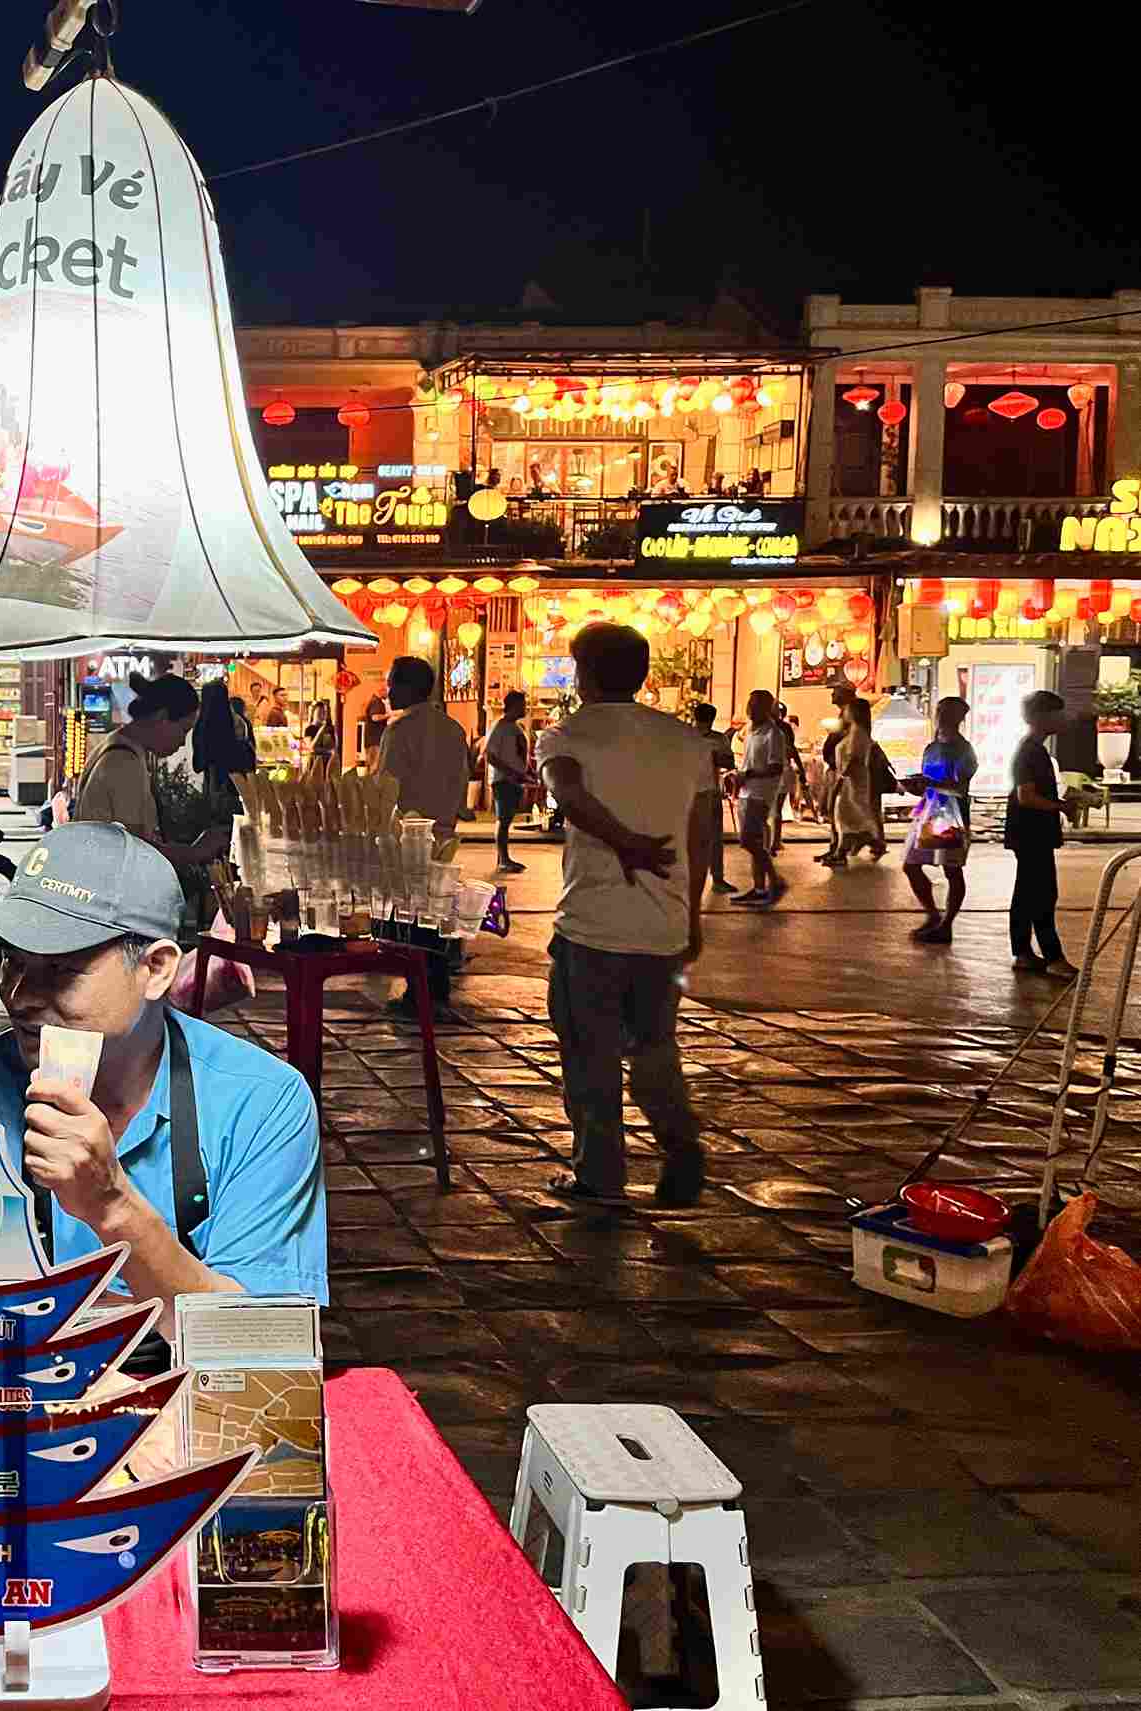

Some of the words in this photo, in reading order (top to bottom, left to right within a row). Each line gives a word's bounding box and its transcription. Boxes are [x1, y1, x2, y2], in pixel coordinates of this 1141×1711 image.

[80, 155, 145, 210] Vé
[268, 481, 318, 513] SPA
[99, 656, 152, 680] ATM
[2, 1578, 53, 1606] AN
